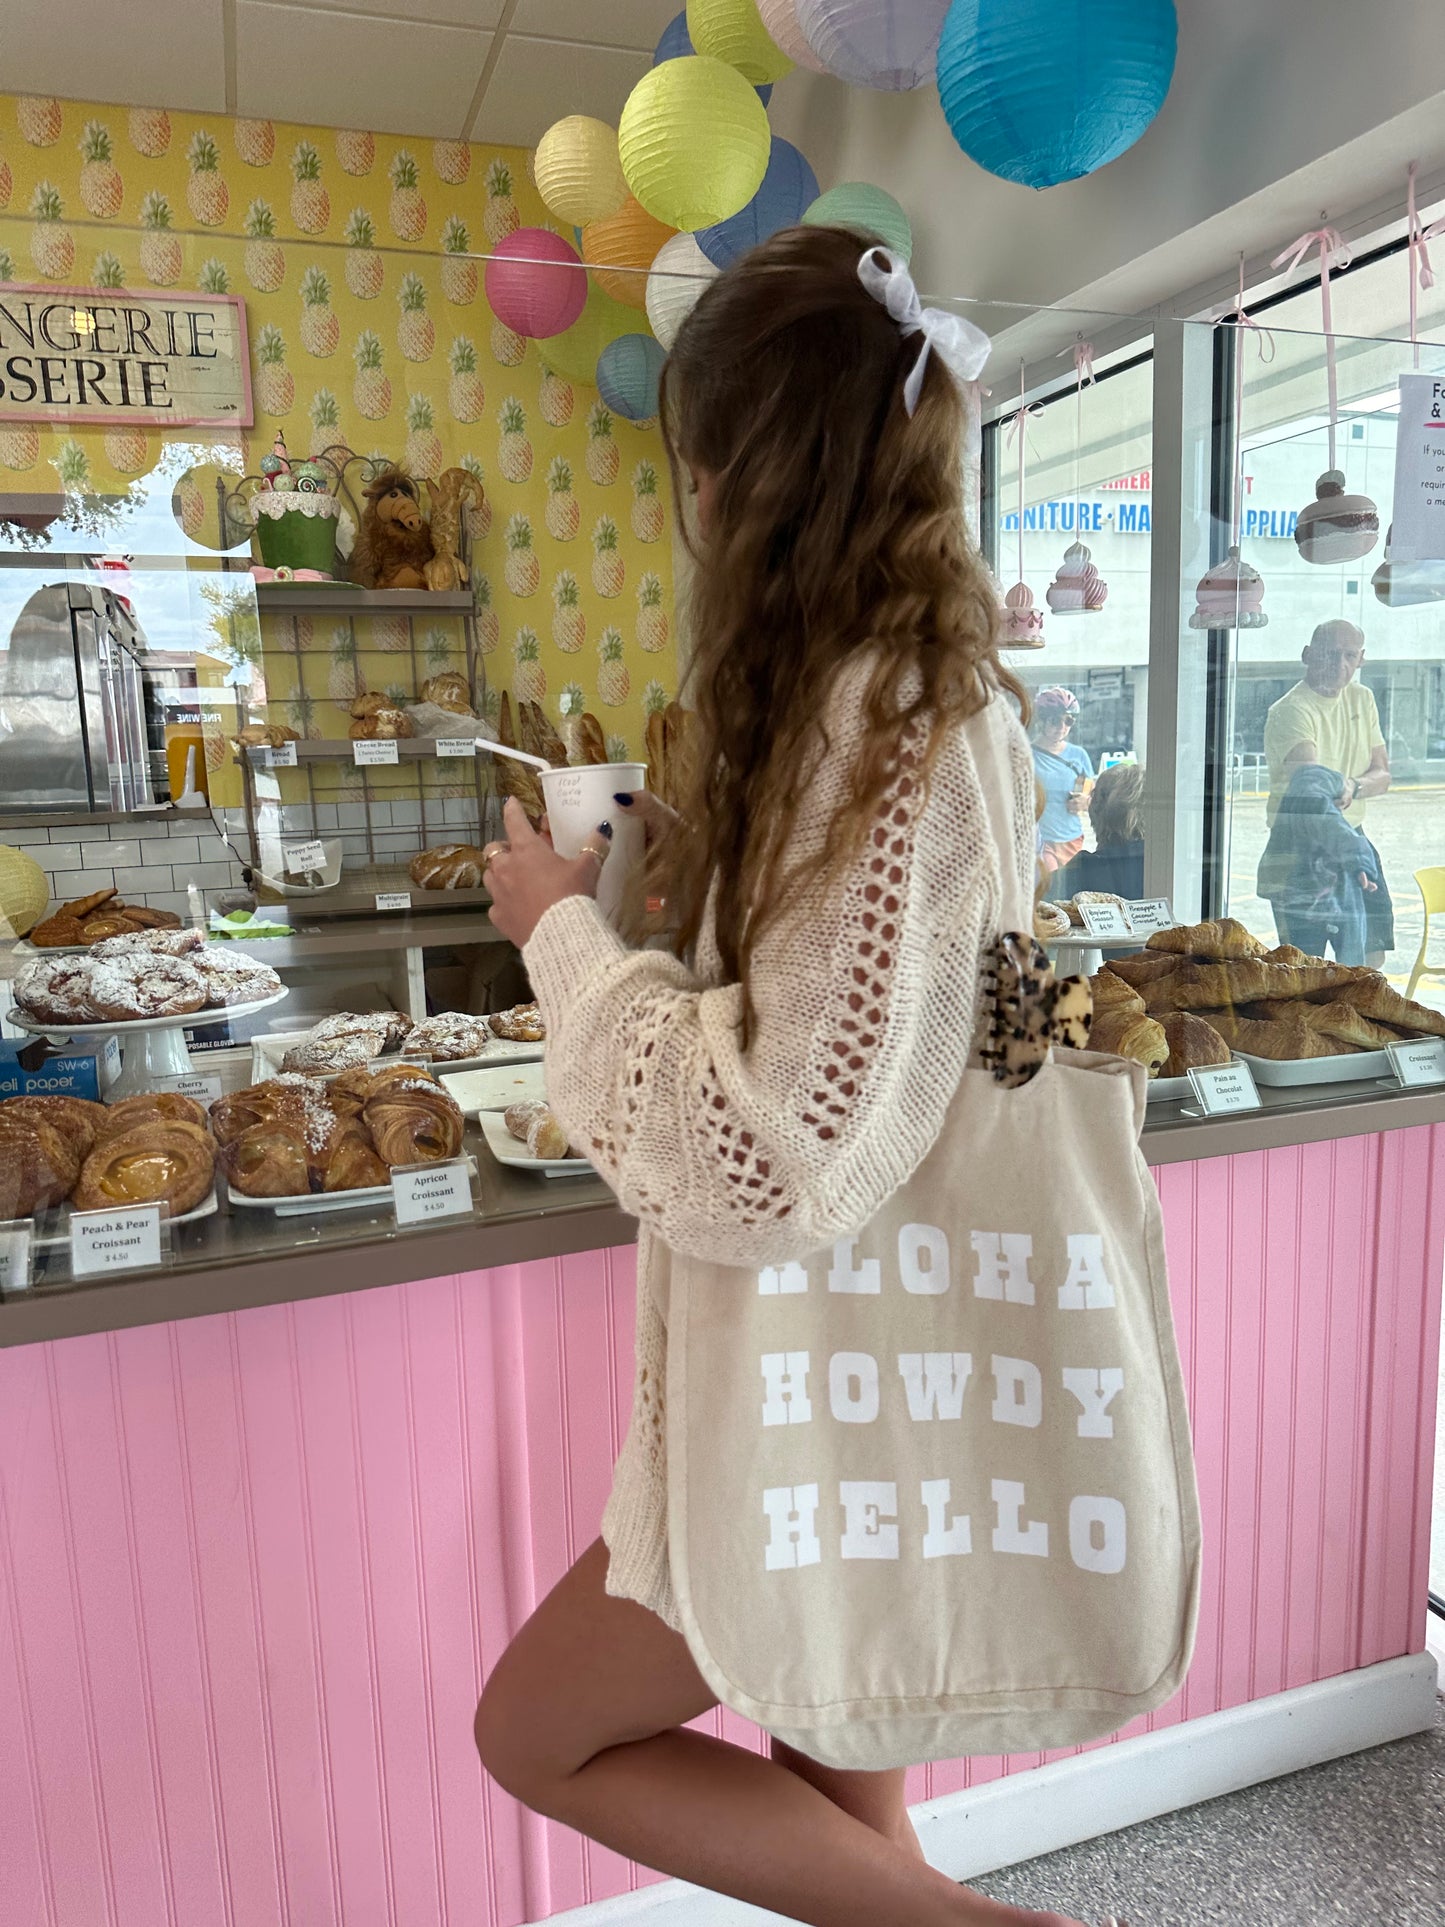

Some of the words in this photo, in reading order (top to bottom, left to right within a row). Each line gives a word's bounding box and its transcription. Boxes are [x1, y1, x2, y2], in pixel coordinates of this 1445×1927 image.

[0, 356, 173, 407] SERIE
[1431, 403, 1441, 418] &
[1423, 444, 1430, 455] If
[1000, 502, 1102, 531] RNITURE
[186, 1041, 212, 1051] POSABLE
[213, 1039, 235, 1048] GLOVES
[0, 1078, 18, 1092] eli
[25, 1076, 75, 1093] paper
[177, 1081, 203, 1090] Cherry
[1213, 1075, 1228, 1083] Pain
[1215, 1085, 1243, 1095] Chocolat
[414, 1174, 448, 1187] Apricot
[411, 1187, 454, 1201] Croissant
[81, 1223, 114, 1236] Peach
[115, 1221, 124, 1232] &
[126, 1219, 151, 1231] Pear
[91, 1236, 142, 1251] Croissant
[760, 1350, 1125, 1439] HOWDY
[763, 1477, 1127, 1575] HELLO
